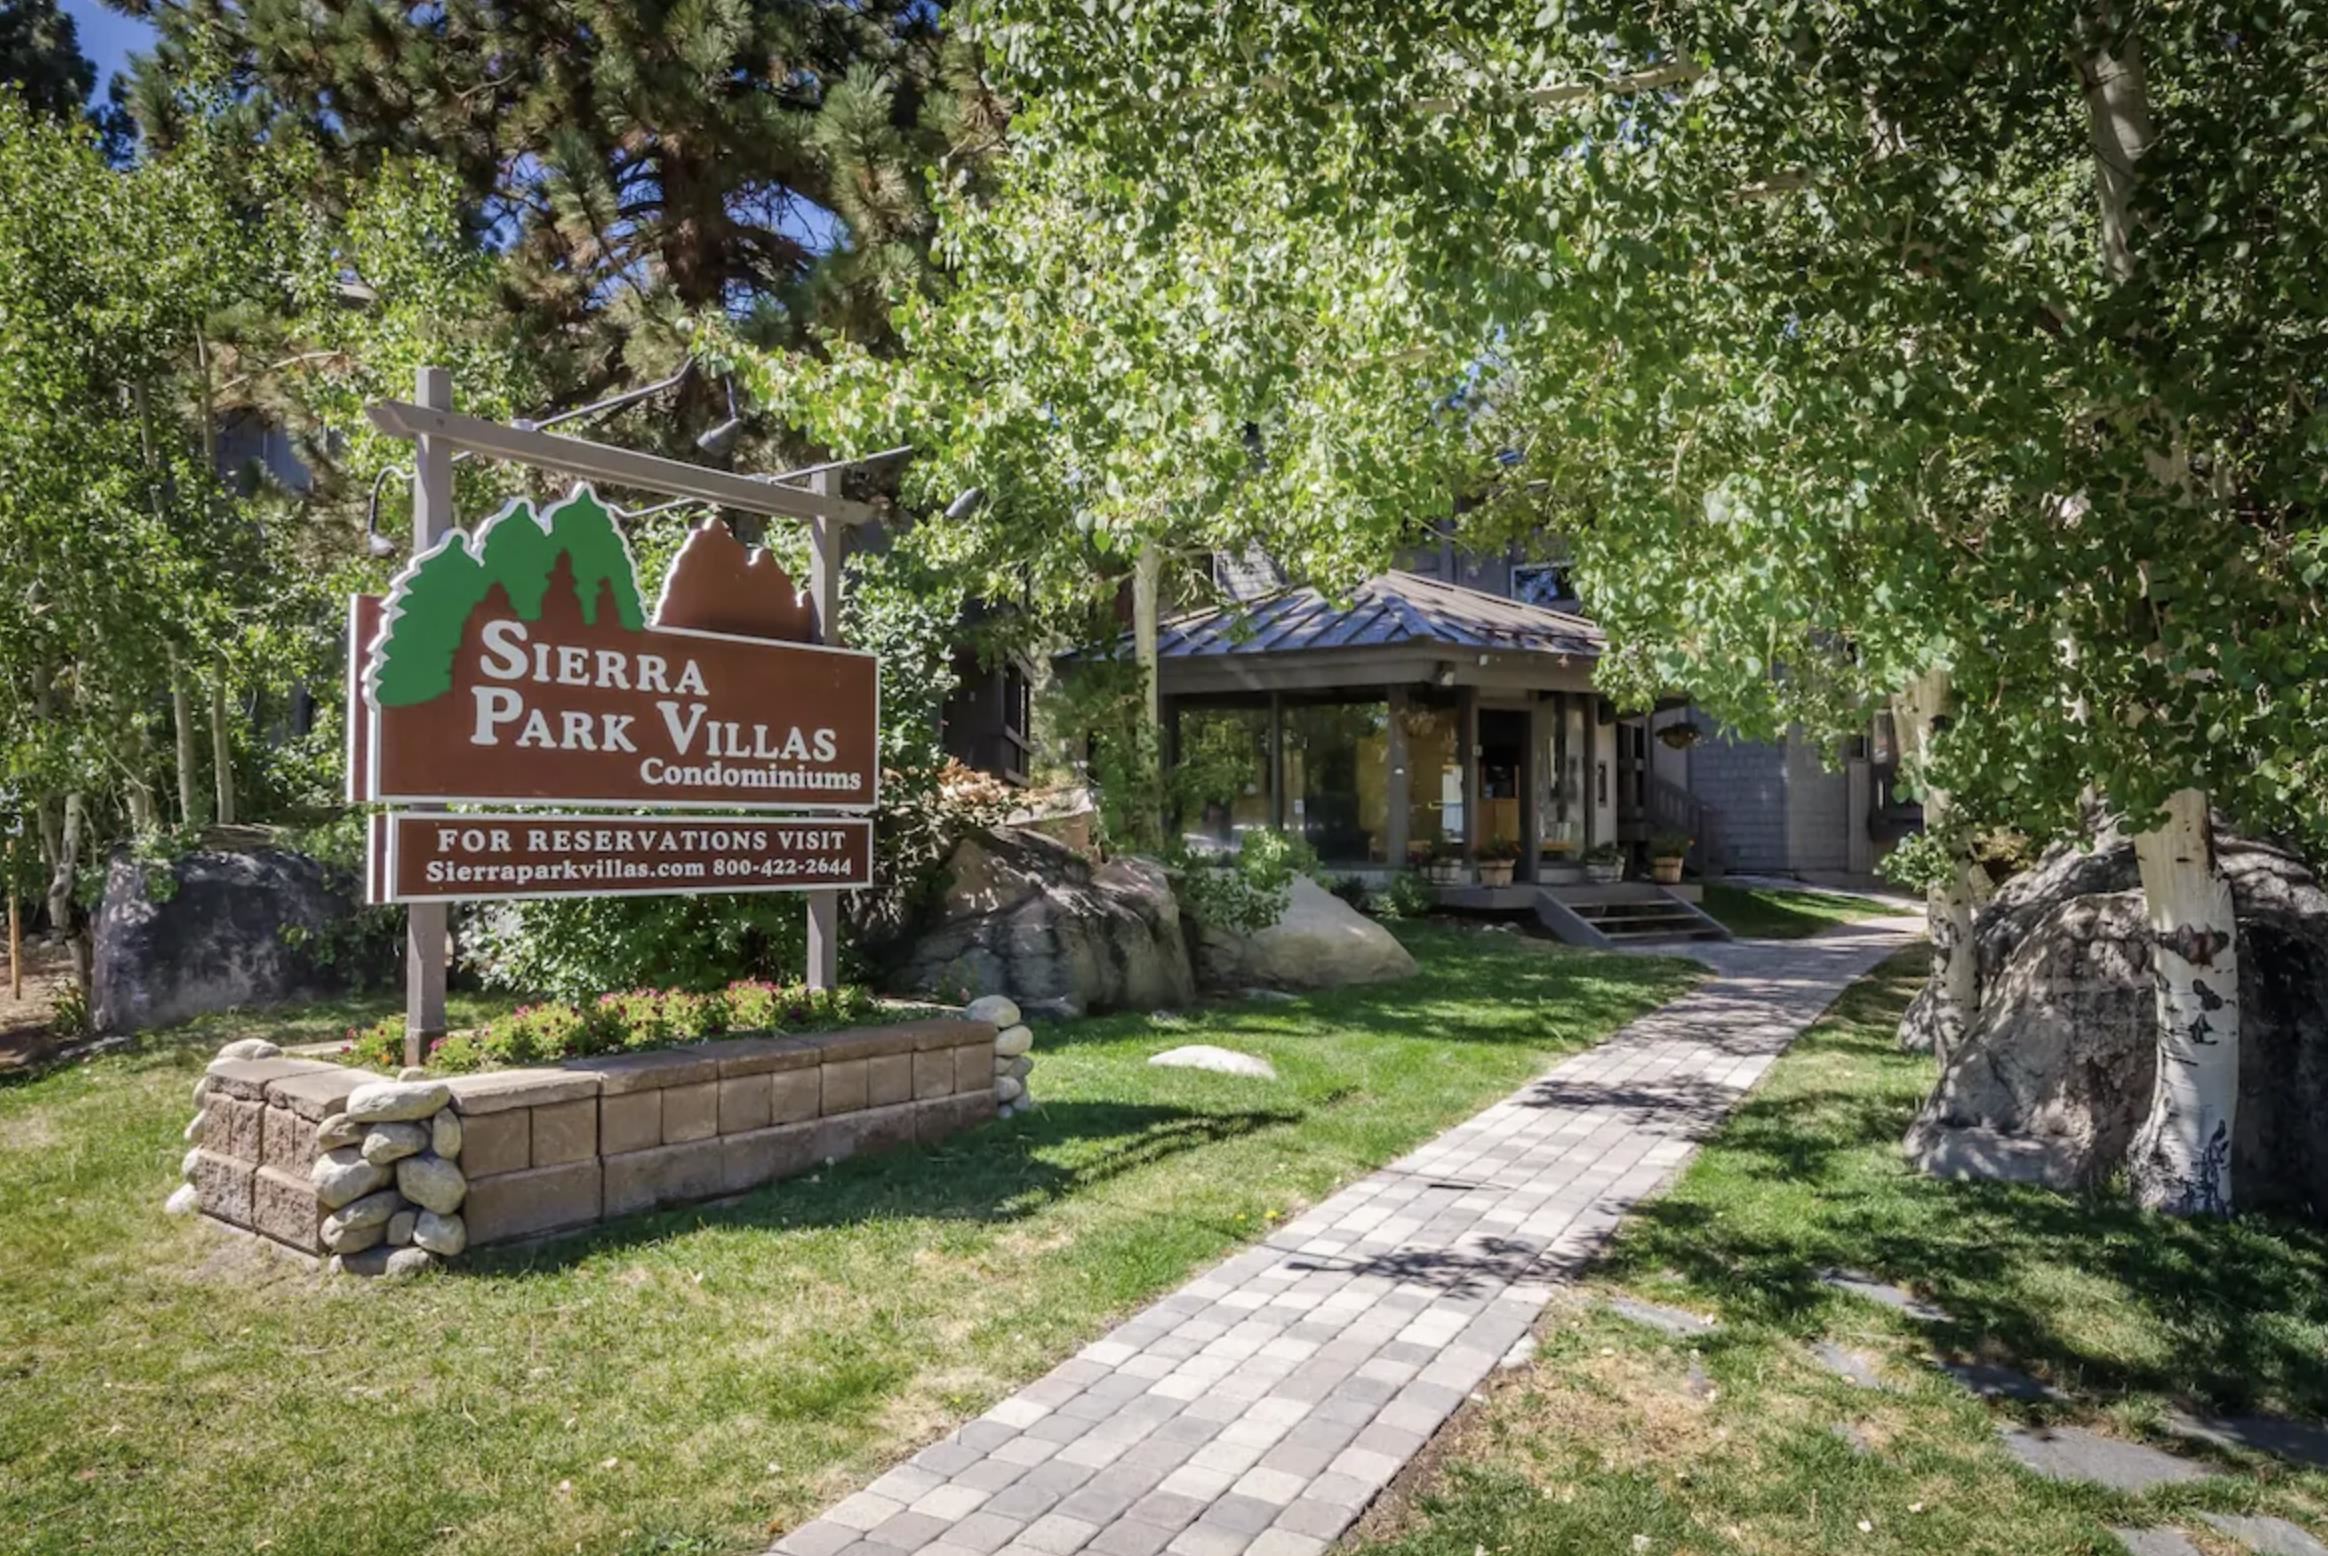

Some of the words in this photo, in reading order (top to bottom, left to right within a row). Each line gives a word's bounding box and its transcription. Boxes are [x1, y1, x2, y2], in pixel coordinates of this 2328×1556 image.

[480, 620, 709, 696] SIERRA
[471, 686, 637, 753] PARK
[656, 700, 837, 762] VILLAS
[640, 758, 862, 790] Condominiums
[438, 829, 511, 852] FOR
[528, 830, 767, 852] RESERVATIONS
[778, 831, 846, 850] VISIT
[426, 859, 705, 885] Sierraparkvillas.com
[713, 857, 851, 877] 800-422-2644
